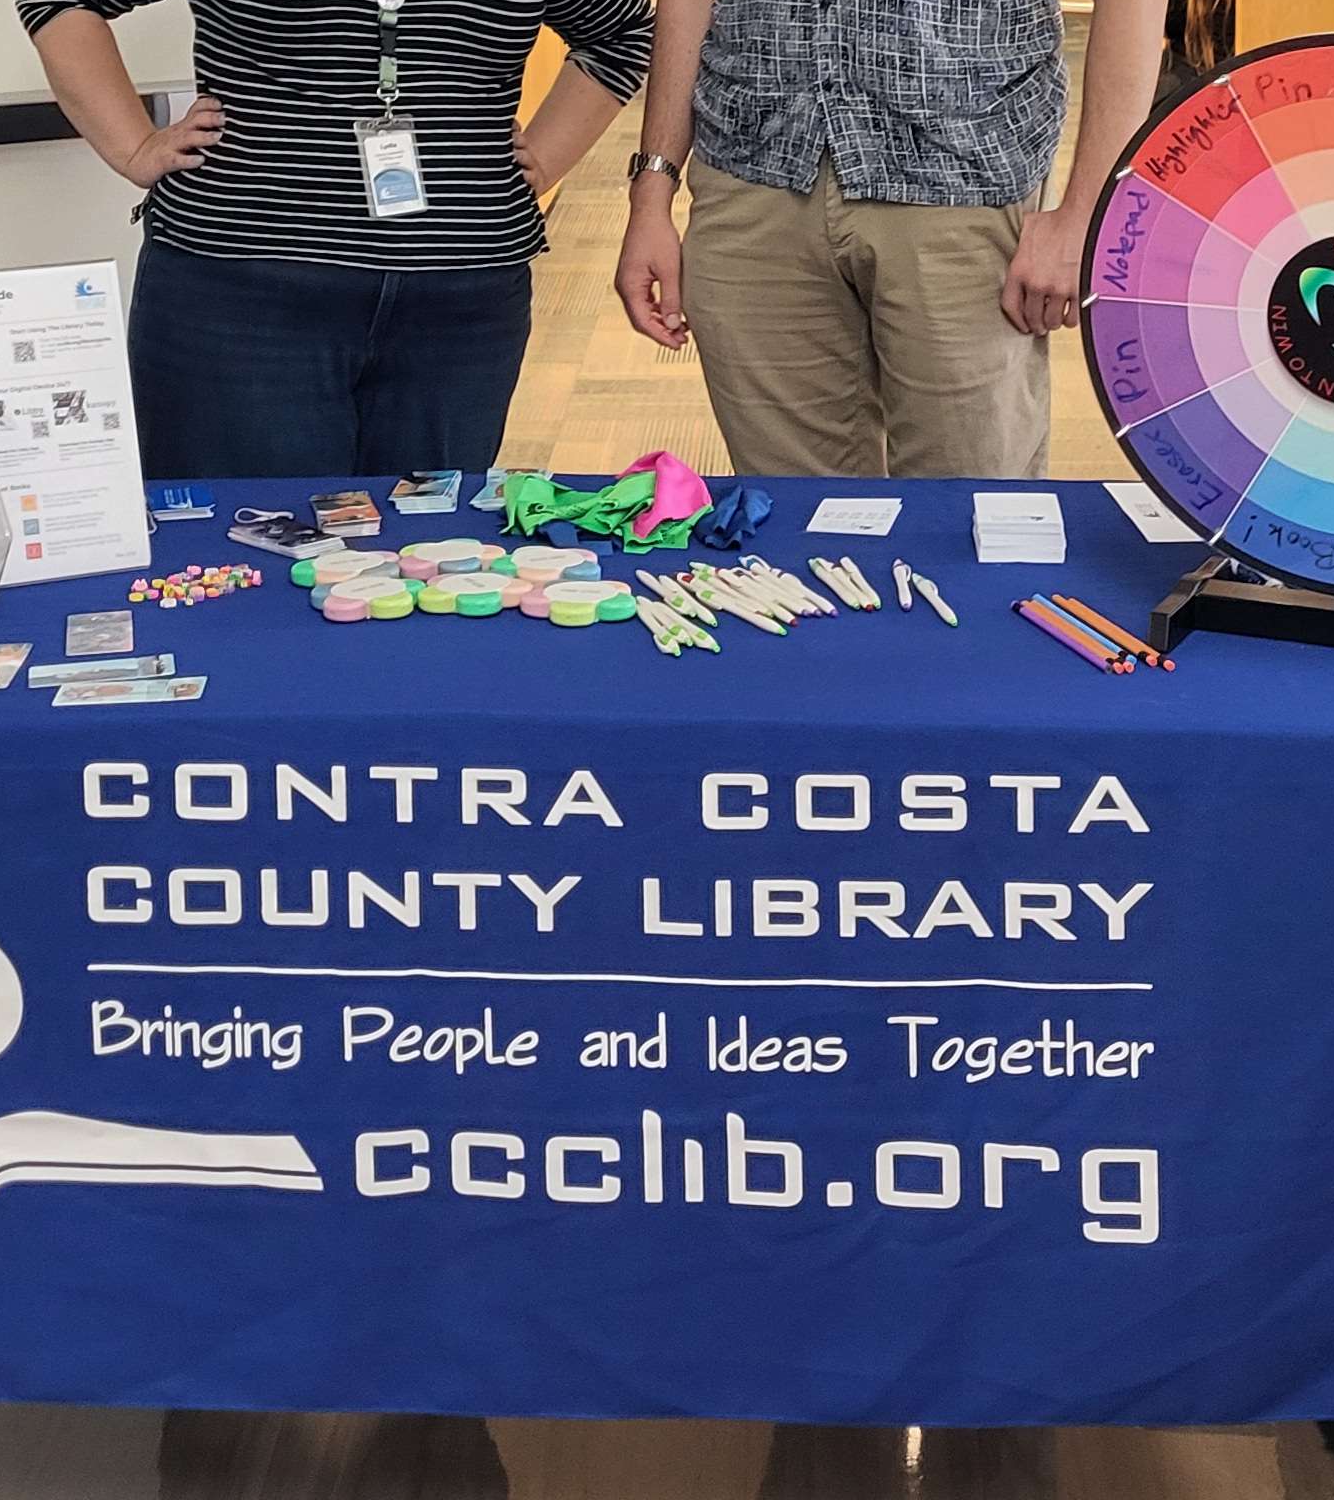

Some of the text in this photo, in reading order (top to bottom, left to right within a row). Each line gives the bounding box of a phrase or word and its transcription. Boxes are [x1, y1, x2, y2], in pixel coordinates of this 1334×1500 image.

[1255, 73, 1317, 103] Pin
[1103, 188, 1149, 293] Notepad
[1271, 305, 1294, 354] WIN
[1110, 337, 1141, 405] Pin
[1289, 357, 1313, 384] TO
[82, 760, 1152, 834] CONTRA COSTA
[85, 865, 1155, 942] COUNTY LIBRARY
[90, 999, 1155, 1084] Bringing People and Ideas Together
[354, 1108, 1161, 1245] ccclib.org
